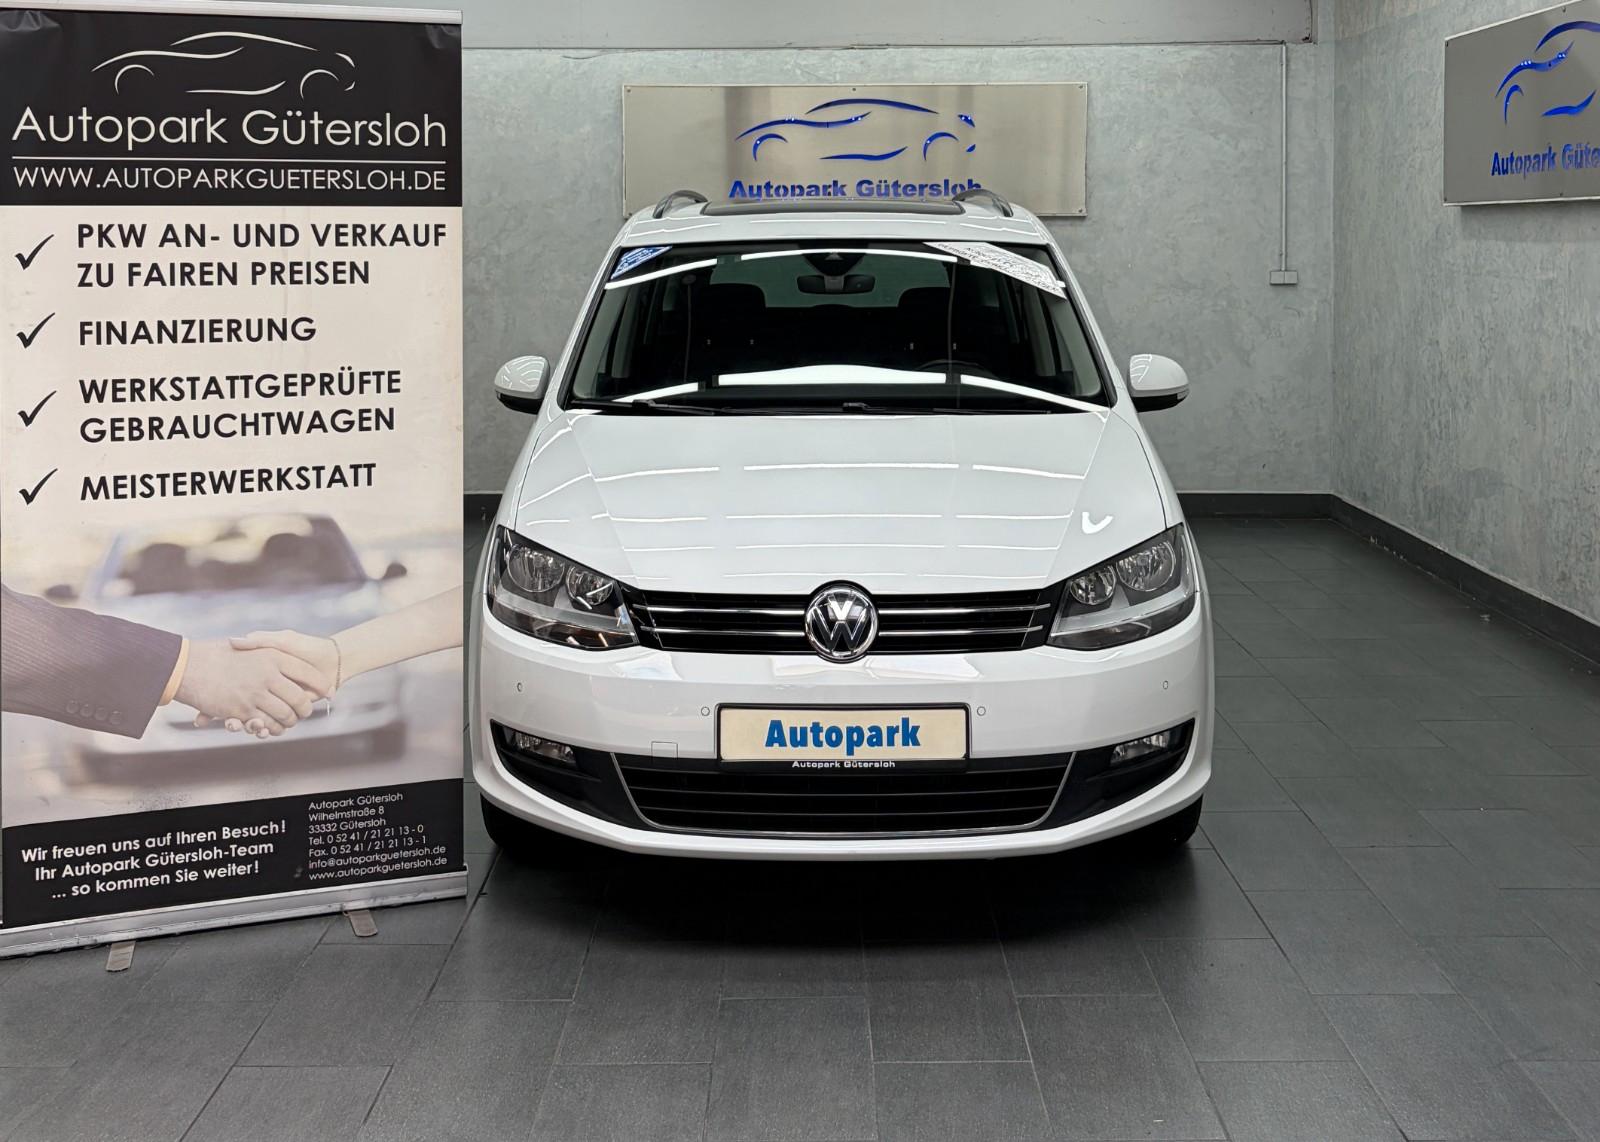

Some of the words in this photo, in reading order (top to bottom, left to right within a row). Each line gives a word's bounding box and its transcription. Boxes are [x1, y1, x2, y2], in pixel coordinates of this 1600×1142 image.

[11, 106, 228, 151] Autopark
[242, 109, 447, 147] Gütersloh
[1491, 145, 1557, 180] Autopark
[13, 166, 446, 191] WWW.AUTOPARKGUETERSLOH.DE
[728, 179, 848, 198] Autopark
[76, 223, 147, 249] PKW
[158, 223, 221, 248] AN-
[233, 223, 300, 248] UND
[311, 223, 447, 247] VERKAUF
[76, 262, 114, 288] ZU
[128, 261, 238, 287] FAIREN
[251, 260, 370, 285] PREISEN
[79, 316, 317, 346] FINANZIERUNG
[79, 366, 401, 404] WERKSTATTGEPRÜFTE
[80, 407, 395, 443] GEBRAUCHTWAGEN
[80, 463, 376, 501] MEISTERWERKSTATT
[765, 717, 921, 756] Autopark
[792, 760, 841, 769] Autopark
[843, 760, 896, 768] Gütersloh
[308, 797, 354, 811] Autopark
[357, 792, 404, 806] Gütersloh
[308, 807, 376, 821] Wilhelmstraße
[378, 805, 385, 815] 8
[308, 822, 337, 834] 33332
[340, 818, 386, 830] Gütersloh
[308, 836, 325, 845] Tel.
[327, 834, 334, 844] 0
[336, 833, 348, 843] 52
[350, 832, 360, 840] 41
[363, 831, 368, 840] /
[370, 829, 381, 838] 21
[384, 827, 394, 837] 21
[399, 826, 410, 835] 13
[417, 824, 424, 833] 0
[22, 847, 48, 862] Wir
[52, 843, 107, 859] freuen
[112, 839, 140, 852] uns
[145, 832, 172, 848] auf
[176, 830, 217, 845] Ihren
[308, 848, 329, 857] Fax.
[330, 846, 338, 855] 0
[340, 844, 351, 854] 52
[353, 843, 364, 851] 41
[367, 842, 372, 851] /
[374, 840, 385, 849] 21
[388, 838, 398, 848] 21
[403, 837, 414, 846] 13
[422, 835, 426, 844] 1
[308, 845, 446, 869] info@autoparkguetersloh.de
[35, 866, 57, 881] Ihr
[61, 856, 140, 876] Autopark
[145, 843, 274, 867] Gütersloh-Team
[308, 857, 448, 881] www.autoparkguetersloh.de
[71, 884, 91, 896] so
[96, 873, 170, 893] kommen
[175, 868, 199, 883] Sie
